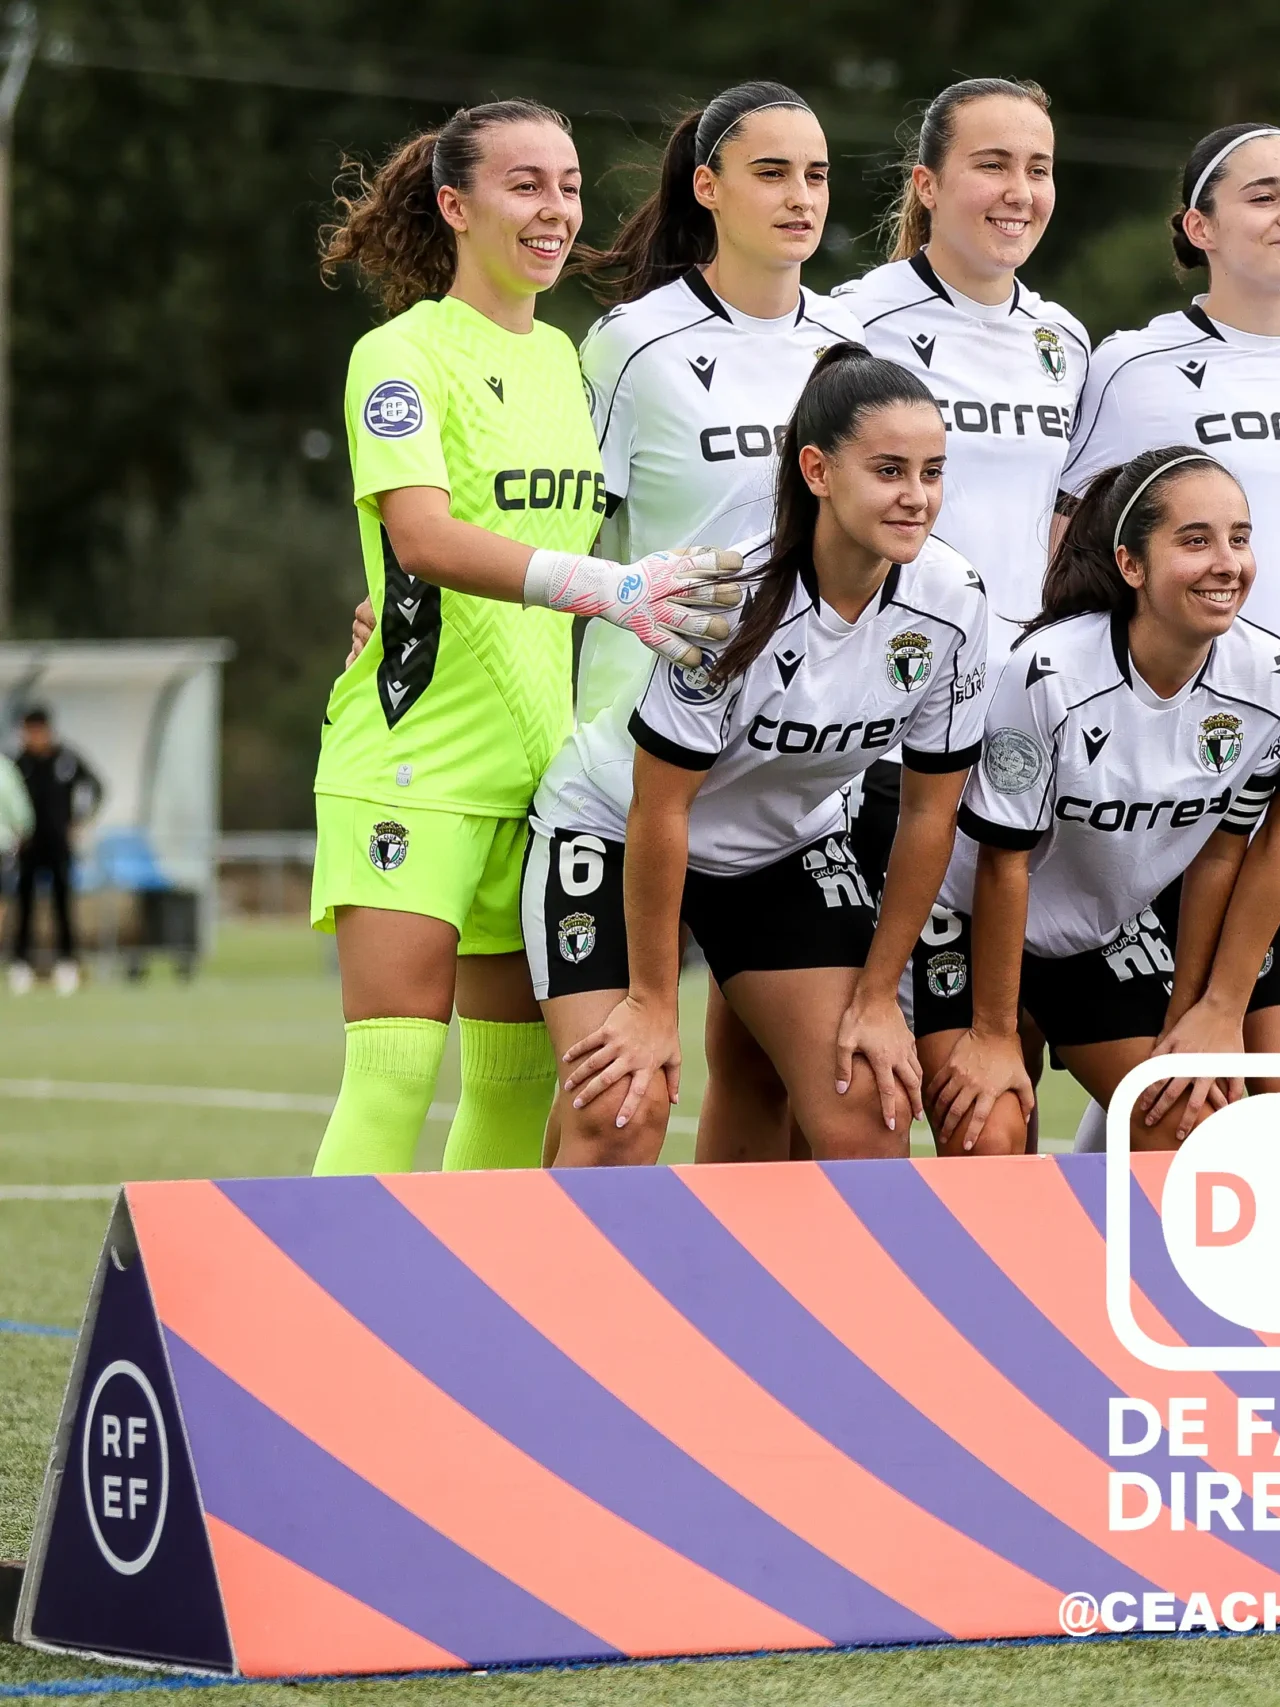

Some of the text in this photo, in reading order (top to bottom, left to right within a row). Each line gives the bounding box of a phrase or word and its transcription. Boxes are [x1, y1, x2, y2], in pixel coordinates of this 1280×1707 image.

[494, 468, 607, 514] corre
[747, 714, 909, 753] corre
[559, 834, 607, 897] 6
[102, 1414, 148, 1459] RF
[103, 1474, 148, 1520] EF
